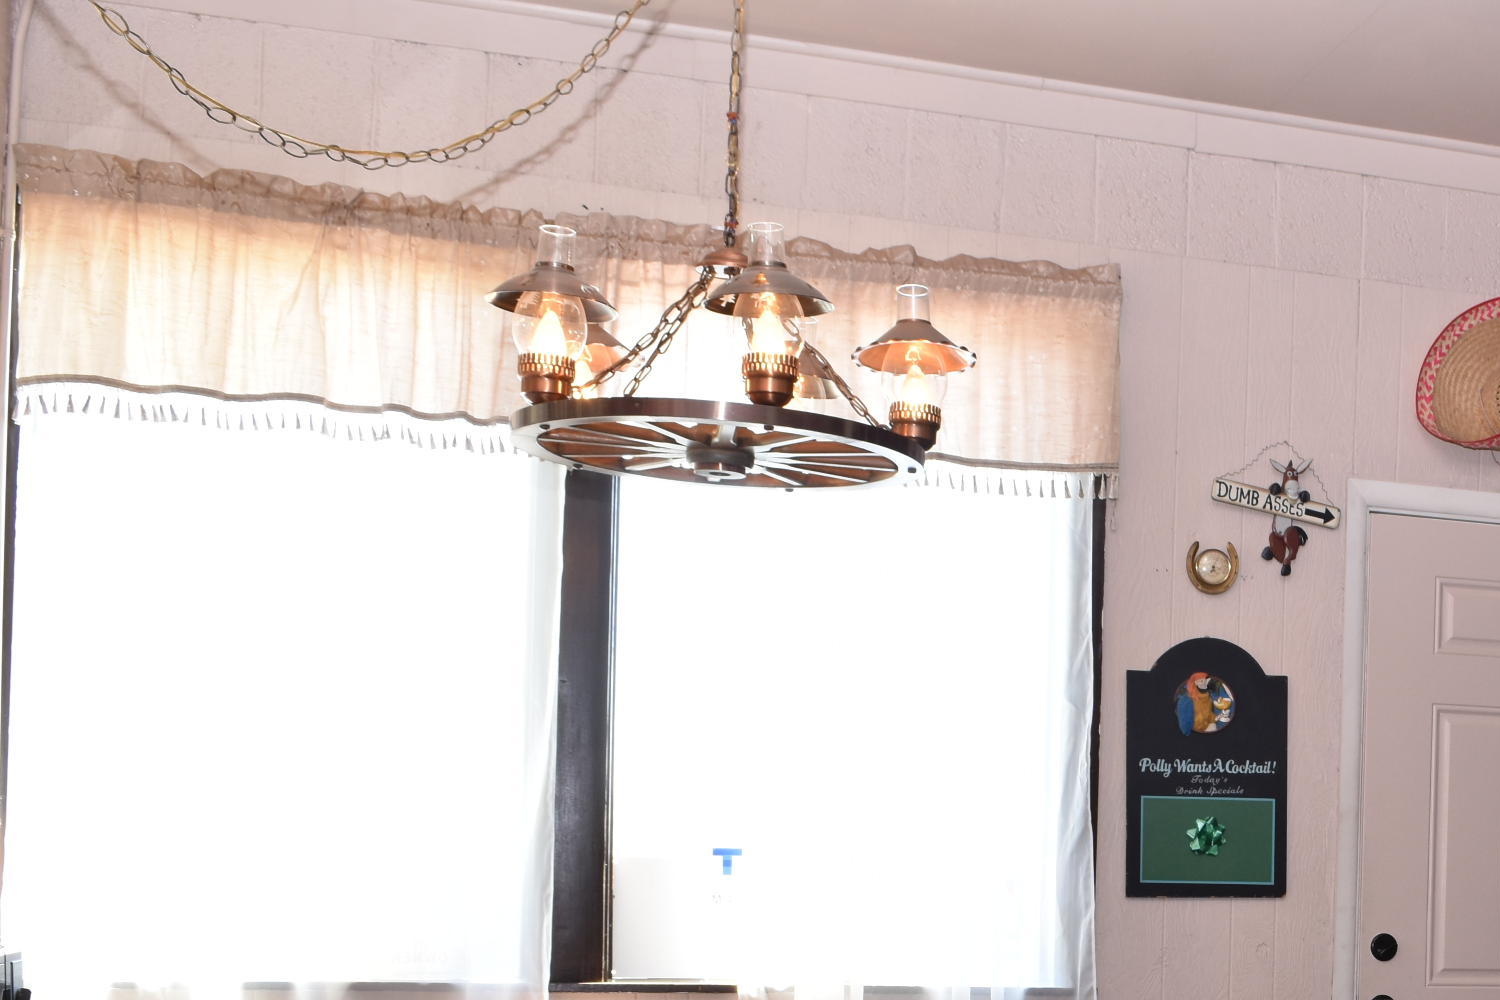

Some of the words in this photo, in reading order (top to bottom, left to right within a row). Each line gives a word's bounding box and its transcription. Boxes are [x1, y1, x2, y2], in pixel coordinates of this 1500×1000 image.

[1216, 480, 1260, 506] DUMB
[1263, 494, 1305, 517] ASSES
[1139, 757, 1172, 778] Polly
[1173, 758, 1212, 773] Wants
[1213, 758, 1225, 774] A
[1225, 759, 1277, 775] Cocktail!
[1176, 786, 1203, 795] Drink
